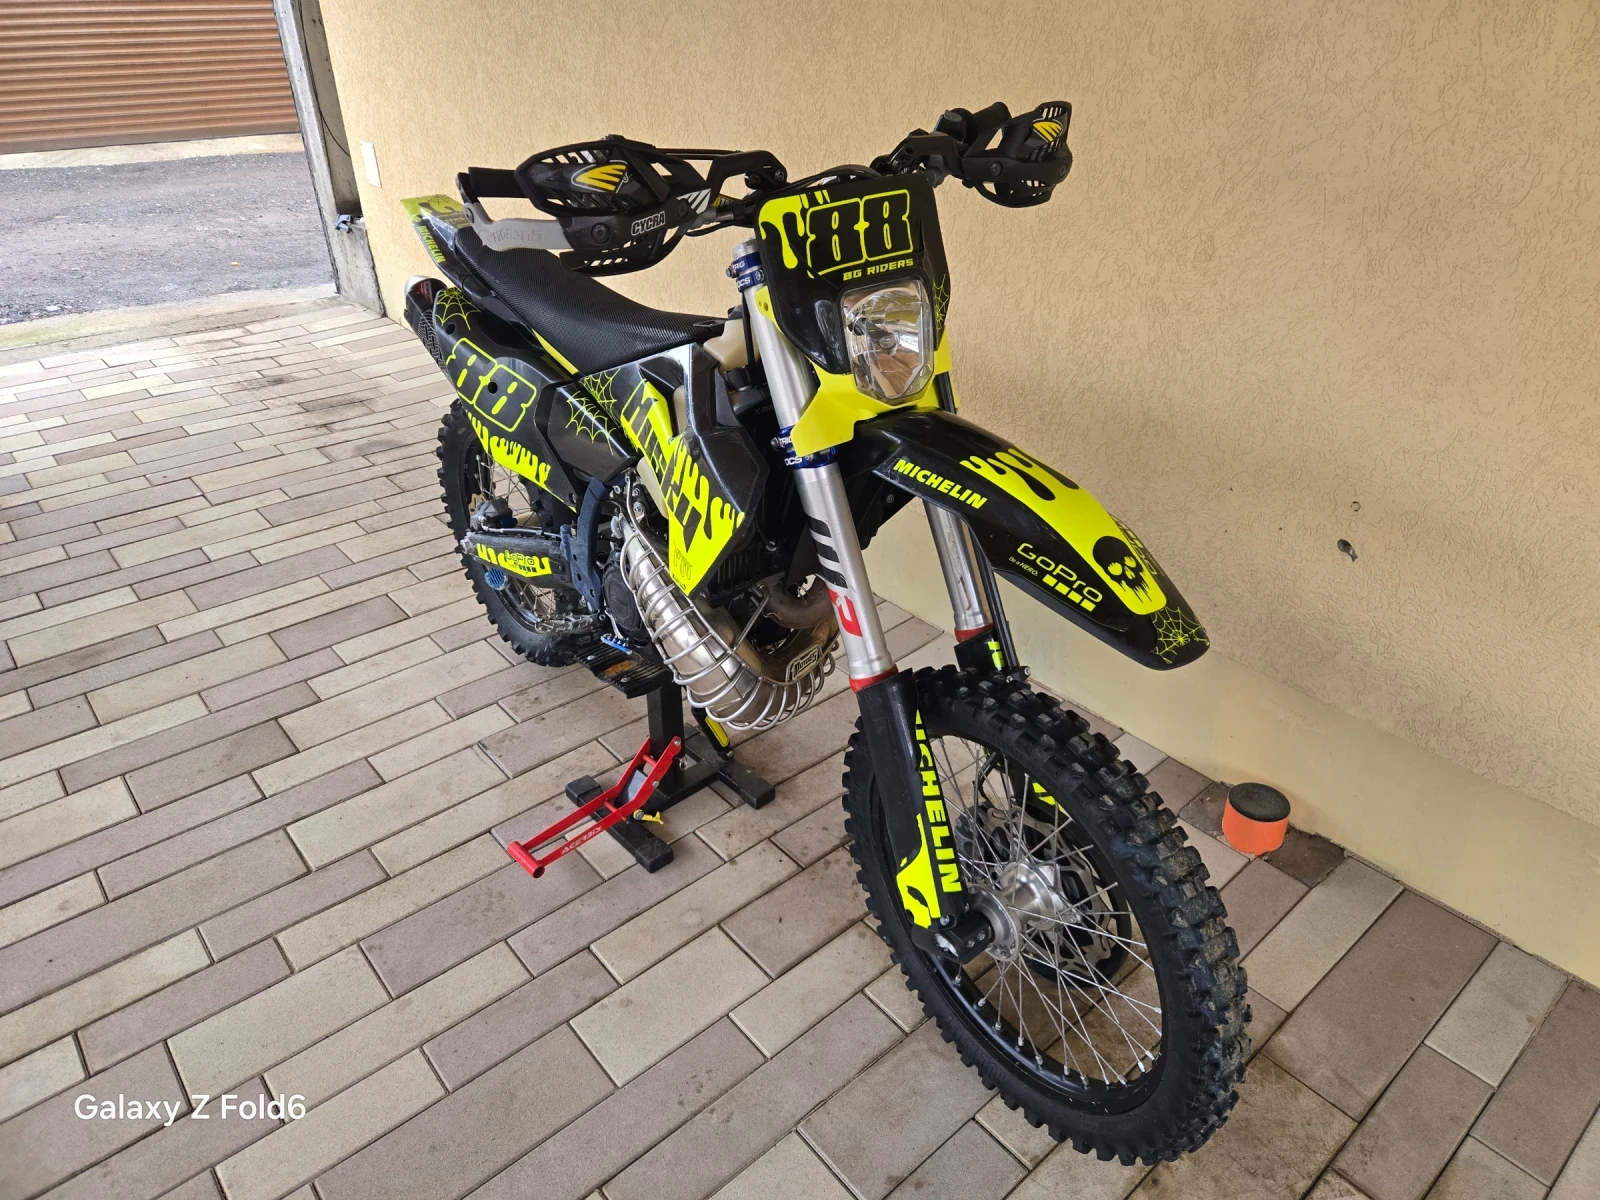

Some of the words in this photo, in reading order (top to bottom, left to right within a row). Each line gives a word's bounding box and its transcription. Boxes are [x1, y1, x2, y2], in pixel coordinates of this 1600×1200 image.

[417, 225, 446, 263] MICHELIN
[631, 211, 665, 236] CYCRA
[843, 269, 862, 281] BG
[866, 258, 914, 277] RIDERS
[894, 459, 987, 509] MICHELIN
[1017, 542, 1103, 603] GoPro
[915, 709, 961, 893] ICHELIN
